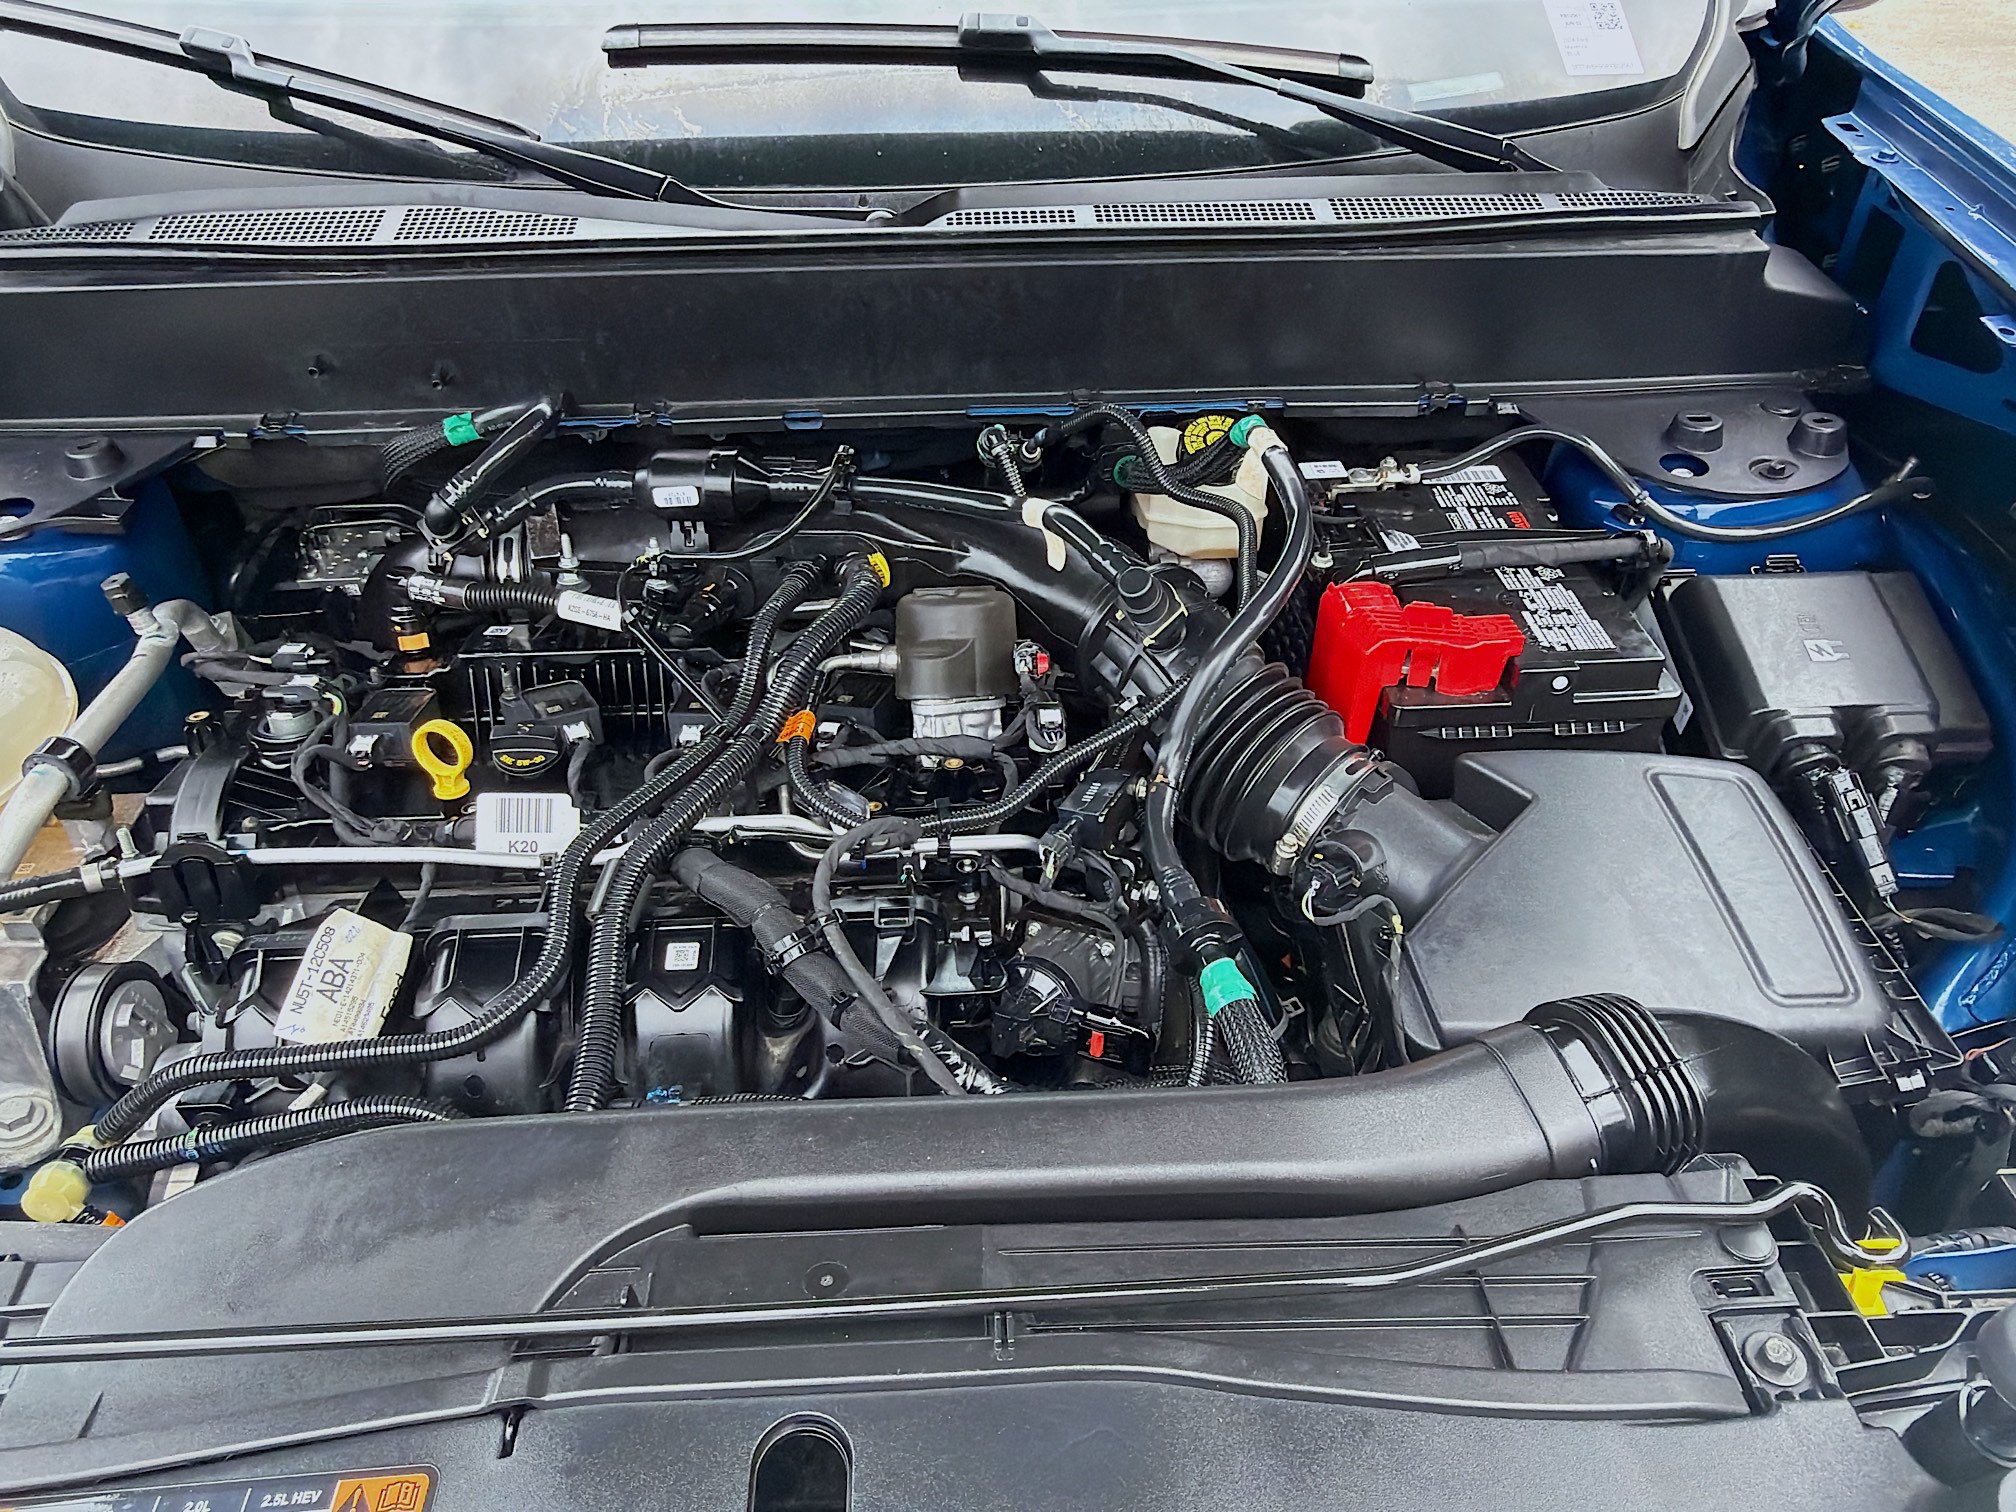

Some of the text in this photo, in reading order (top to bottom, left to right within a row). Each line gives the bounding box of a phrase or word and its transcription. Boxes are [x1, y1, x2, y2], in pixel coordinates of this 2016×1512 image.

[508, 840, 539, 854] K20
[290, 926, 336, 1015] NU5T-12C508
[316, 959, 354, 1004] ABA
[260, 1489, 322, 1508] 2.5L HEV
